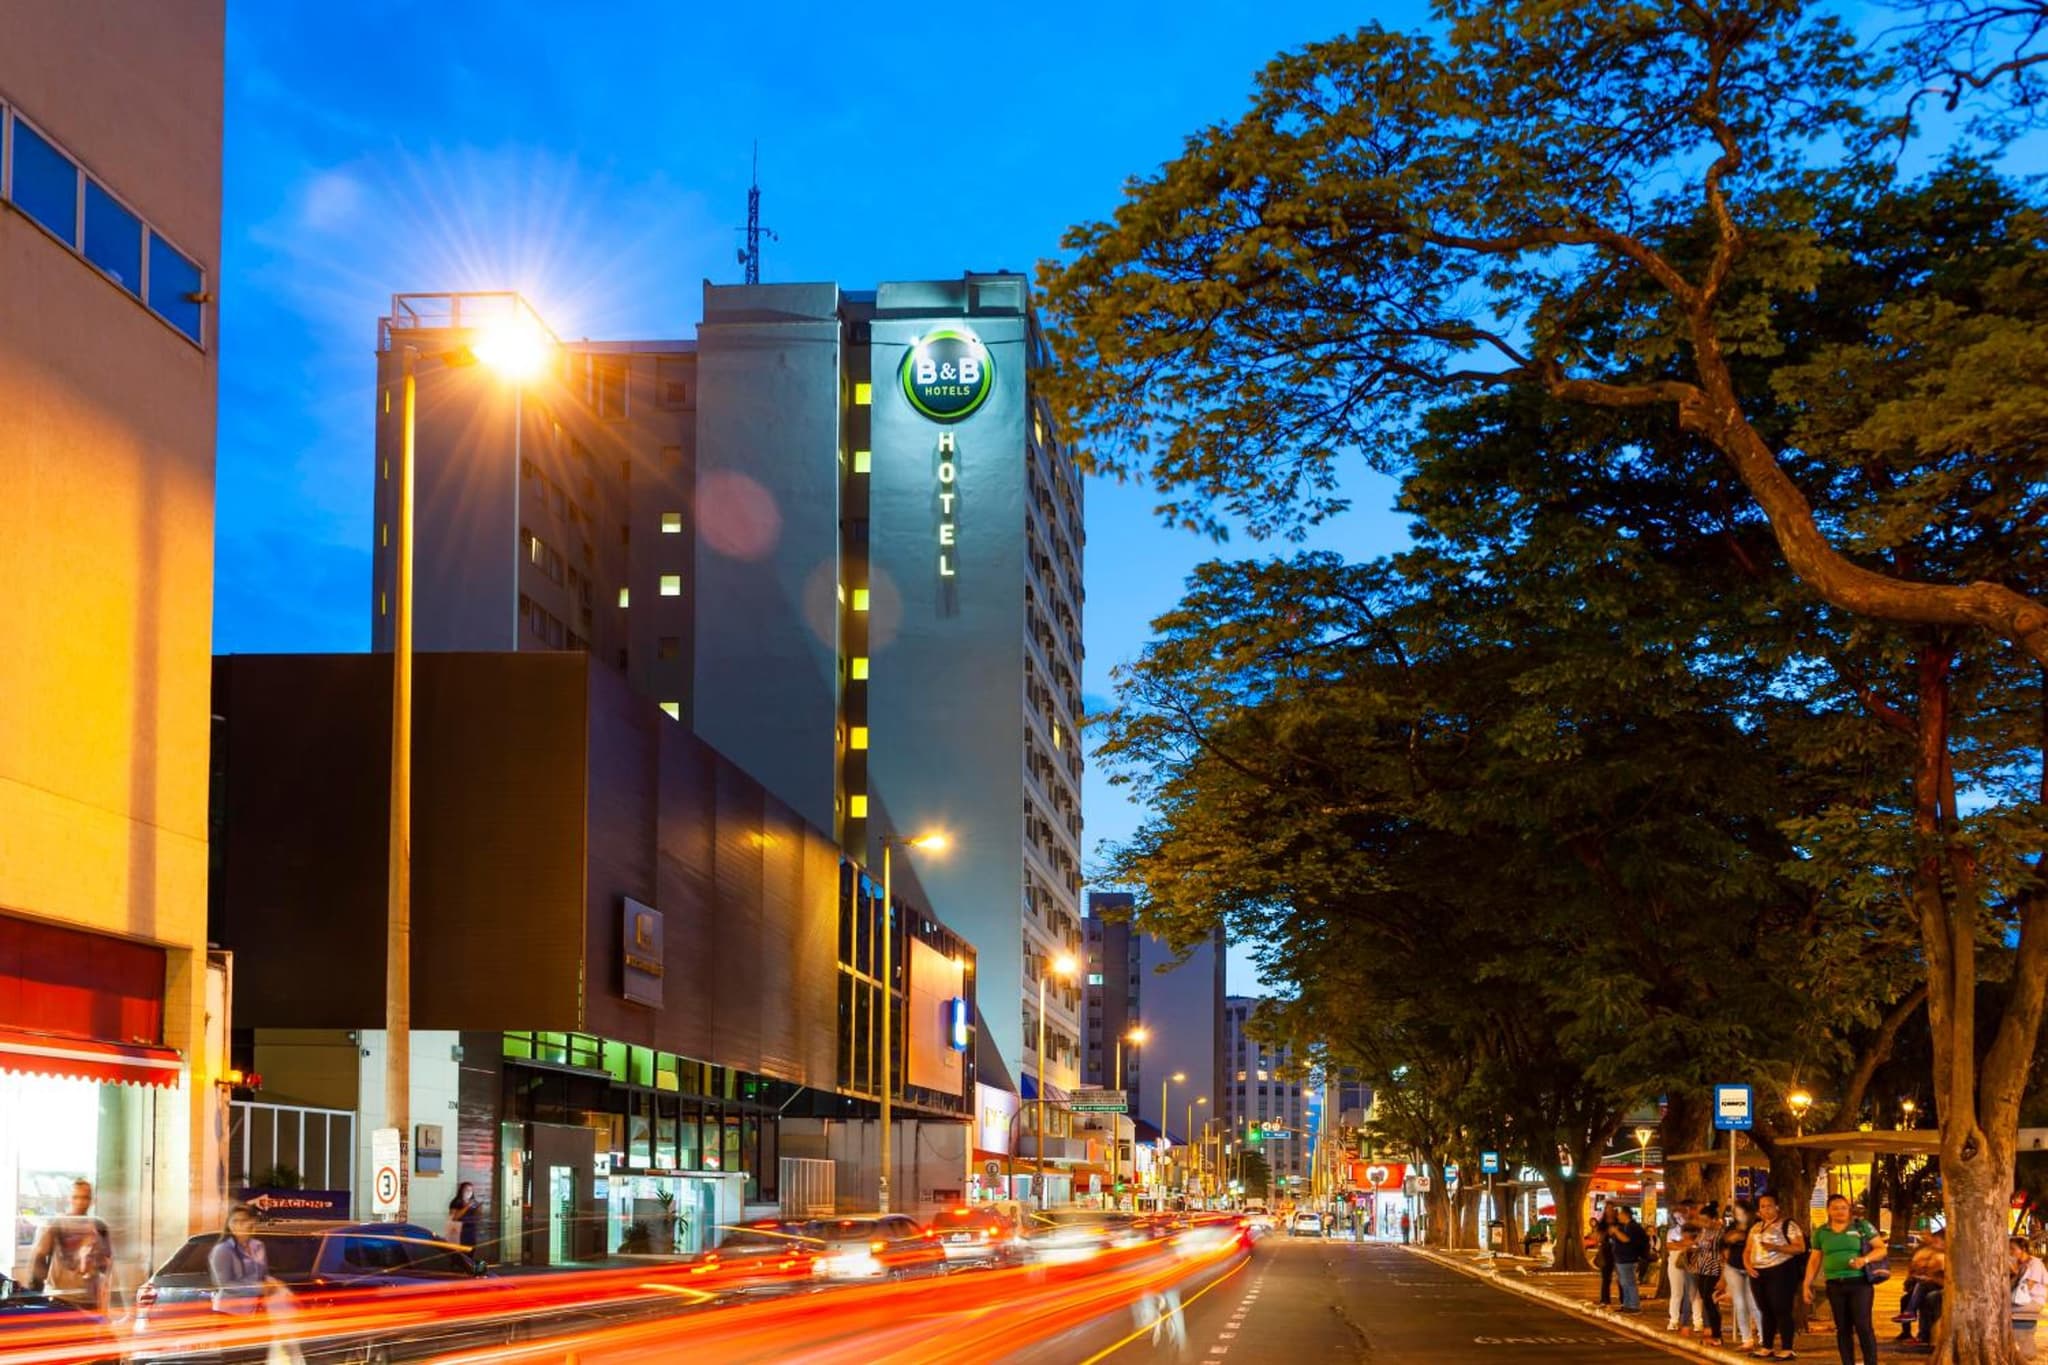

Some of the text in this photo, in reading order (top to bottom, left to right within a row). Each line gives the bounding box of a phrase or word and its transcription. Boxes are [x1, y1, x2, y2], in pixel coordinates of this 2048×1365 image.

[917, 358, 979, 384] B&B
[925, 386, 970, 395] HOTELS
[939, 432, 954, 576] HOTEL
